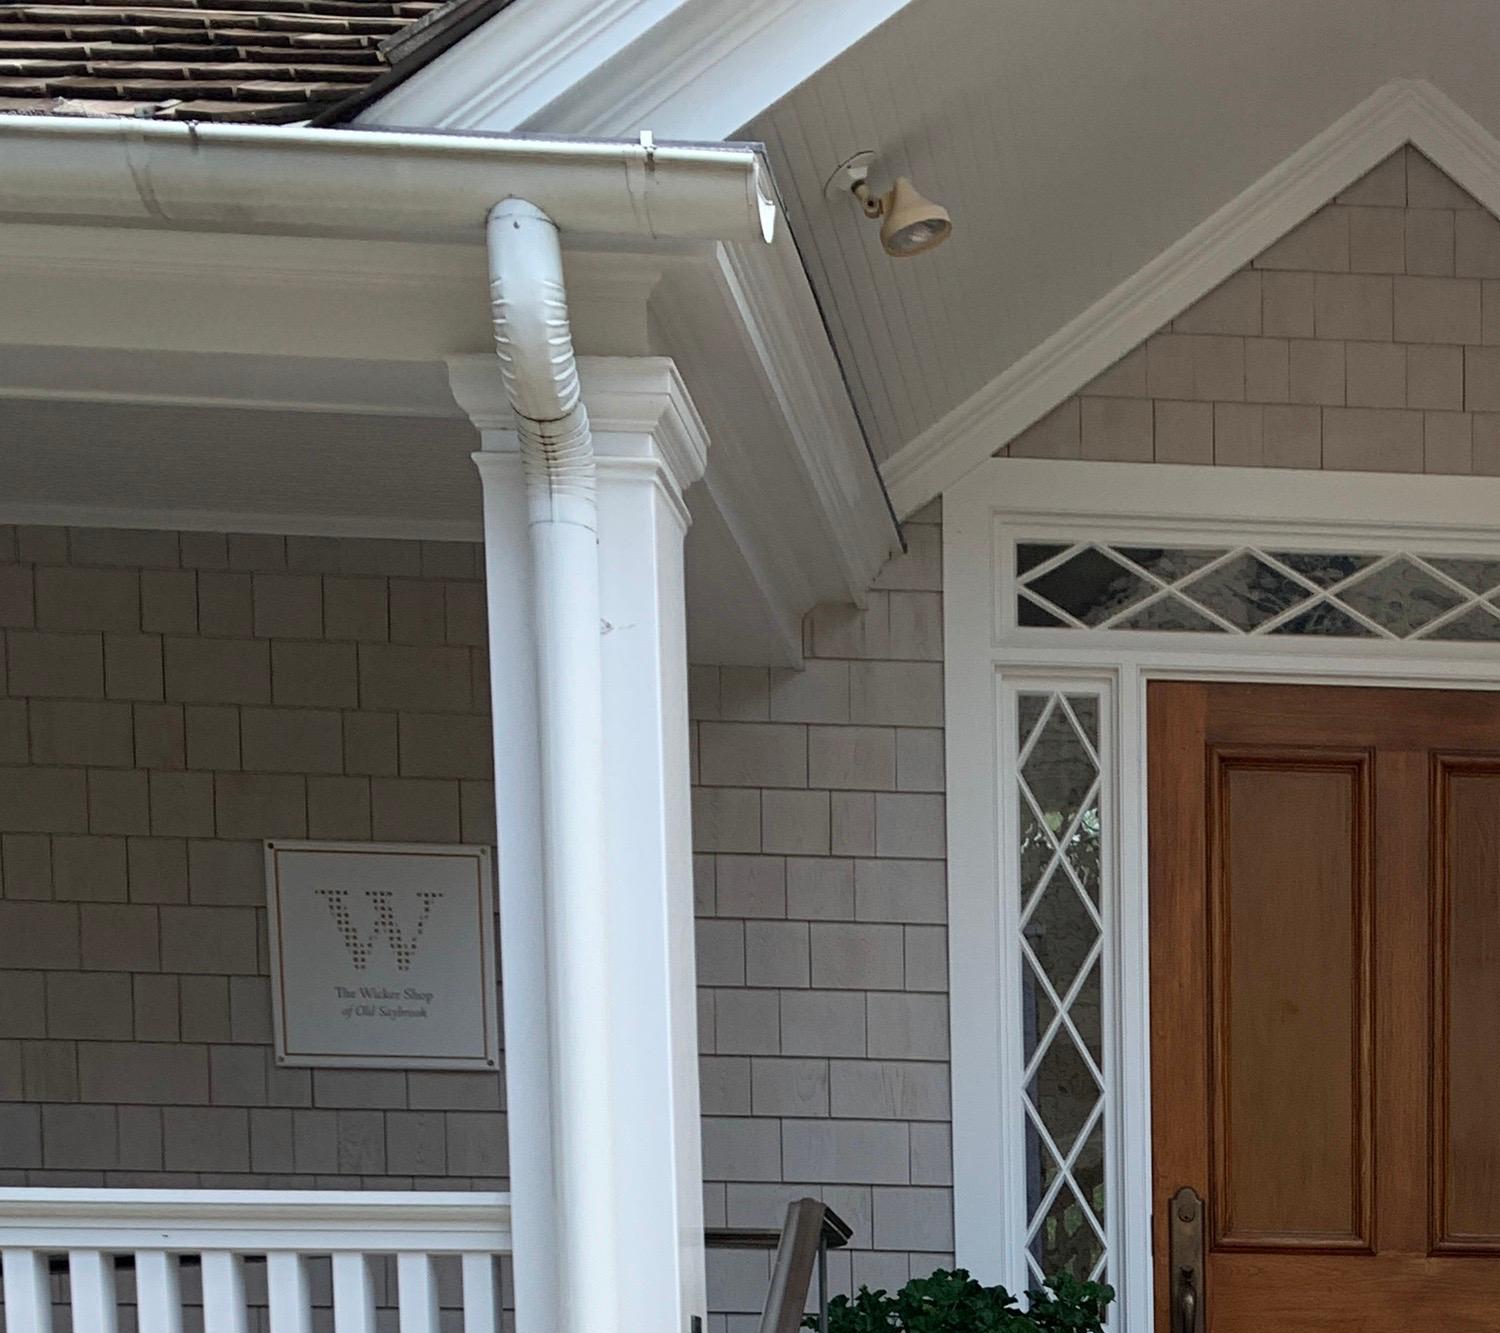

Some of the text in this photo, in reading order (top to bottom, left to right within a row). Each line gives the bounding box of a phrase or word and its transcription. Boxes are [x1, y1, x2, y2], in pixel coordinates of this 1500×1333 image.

[314, 889, 444, 971] W
[334, 986, 434, 1004] The Wicker Shop
